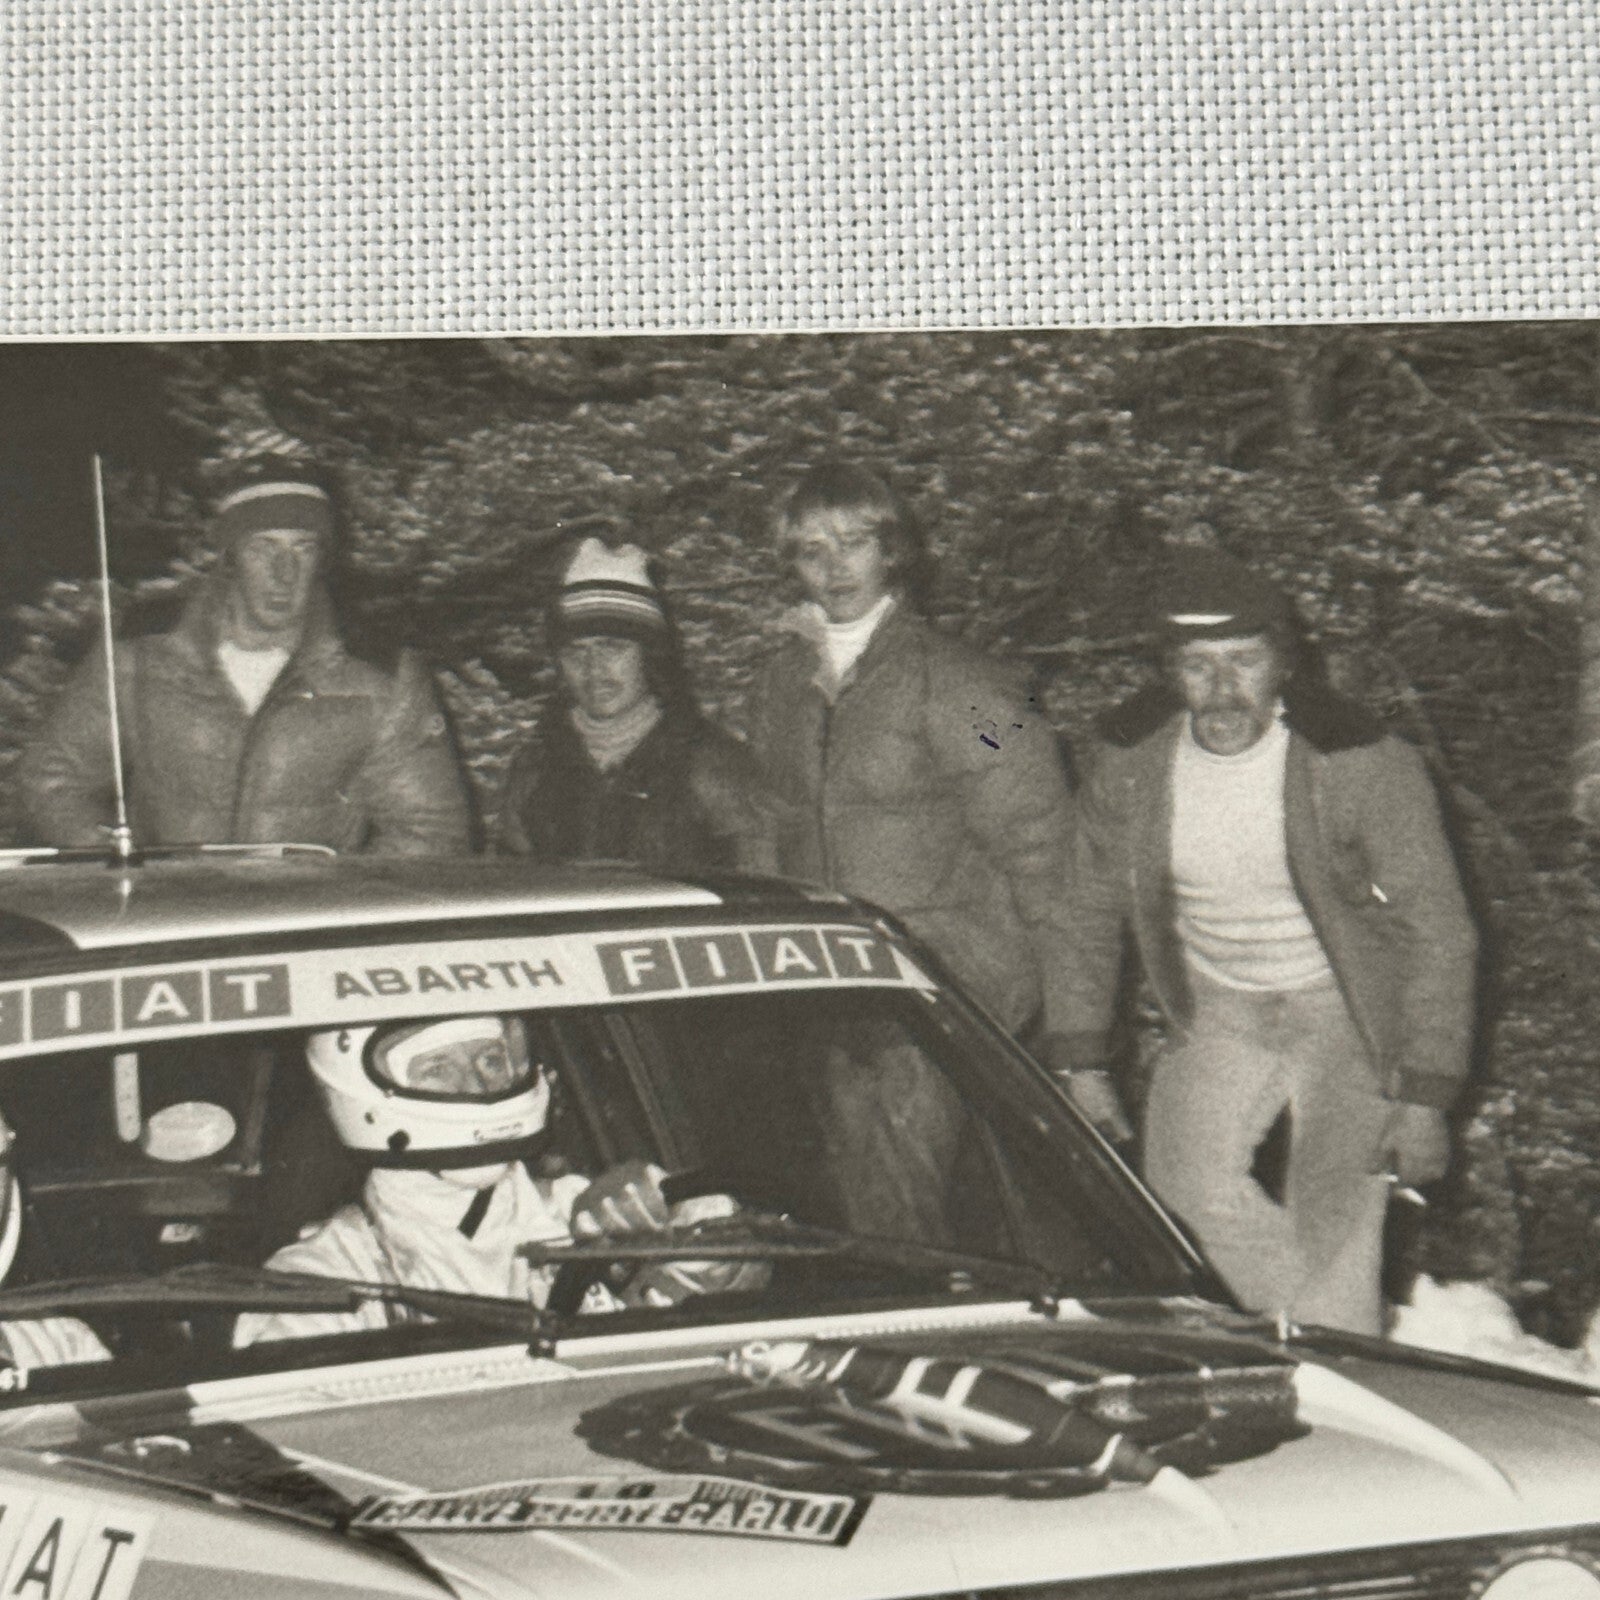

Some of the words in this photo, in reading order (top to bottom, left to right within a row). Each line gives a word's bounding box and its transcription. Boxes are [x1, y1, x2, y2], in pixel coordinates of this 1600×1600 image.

[0, 972, 273, 1030] IAT
[333, 959, 564, 999] ABARTH
[619, 936, 875, 986] FIAT
[0, 1504, 135, 1600] AT
